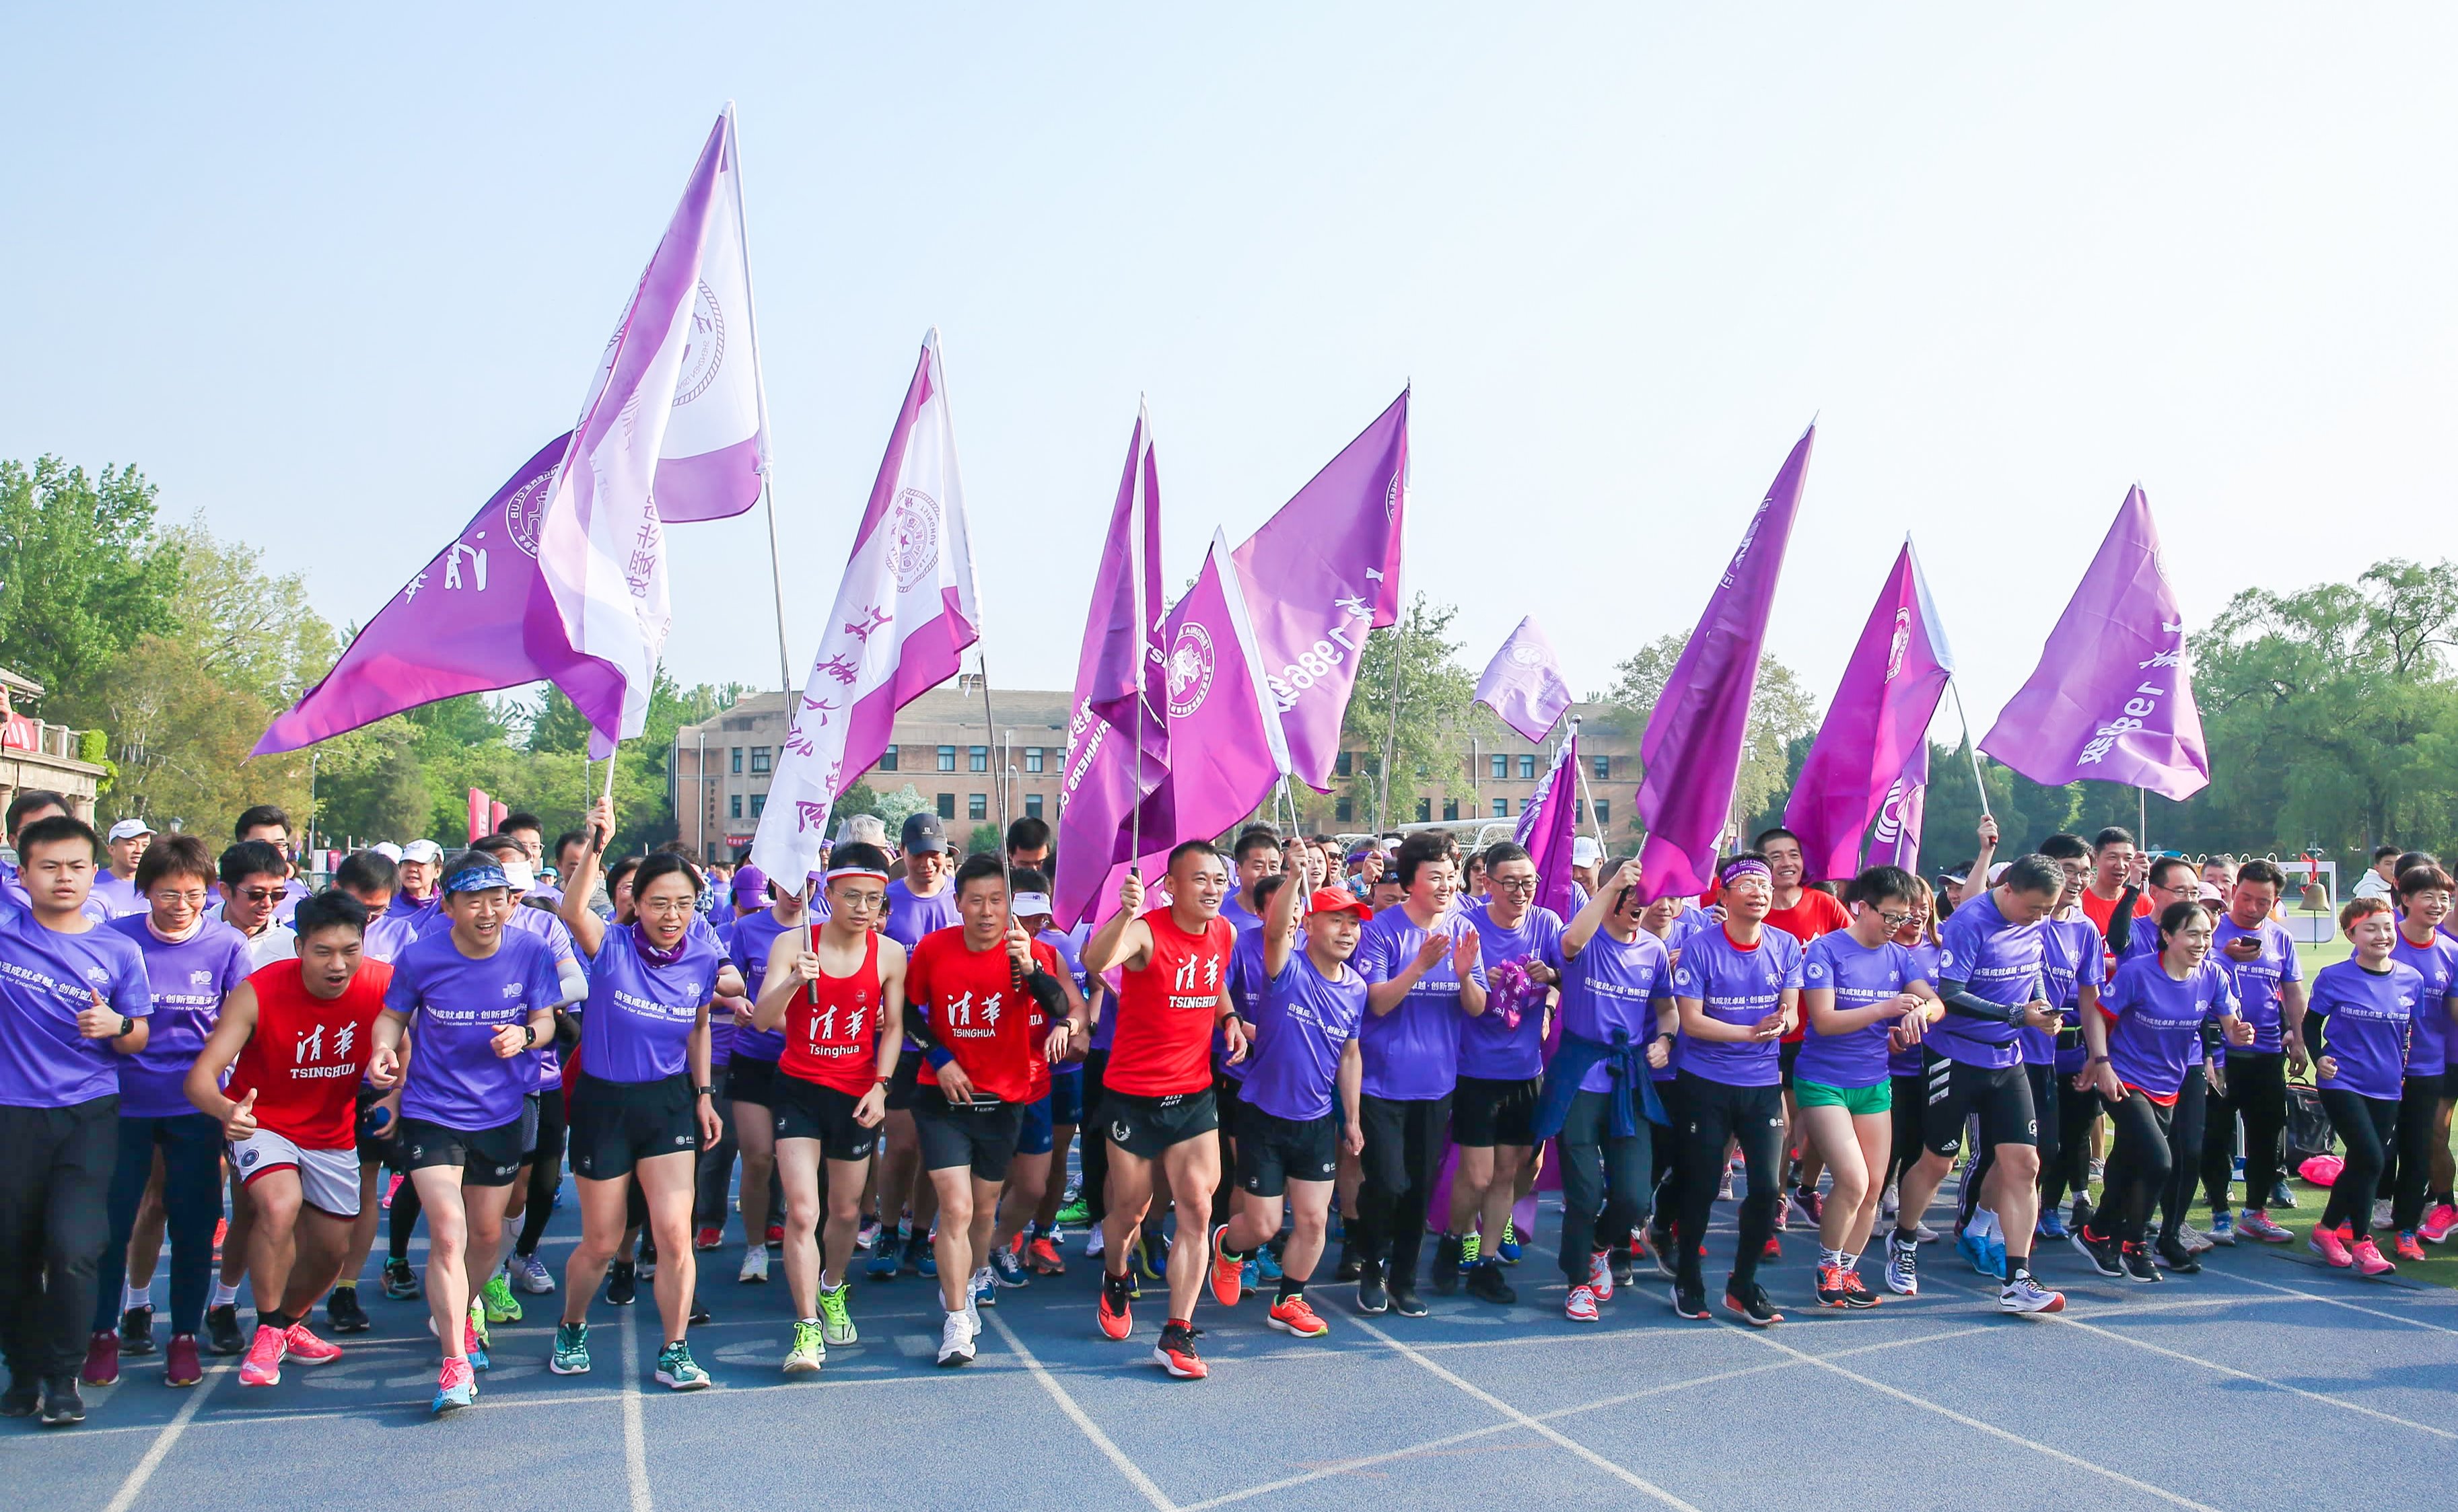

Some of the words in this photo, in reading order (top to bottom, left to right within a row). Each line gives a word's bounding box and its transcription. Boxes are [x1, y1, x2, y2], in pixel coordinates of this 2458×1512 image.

[15, 978, 47, 995] Excellence
[636, 1009, 664, 1020] Excellence
[952, 1028, 997, 1039] TSINGHUA
[808, 1042, 861, 1059] Tsinghua
[290, 1063, 356, 1080] TSINGHUA
[1160, 1099, 1181, 1108] PORT
